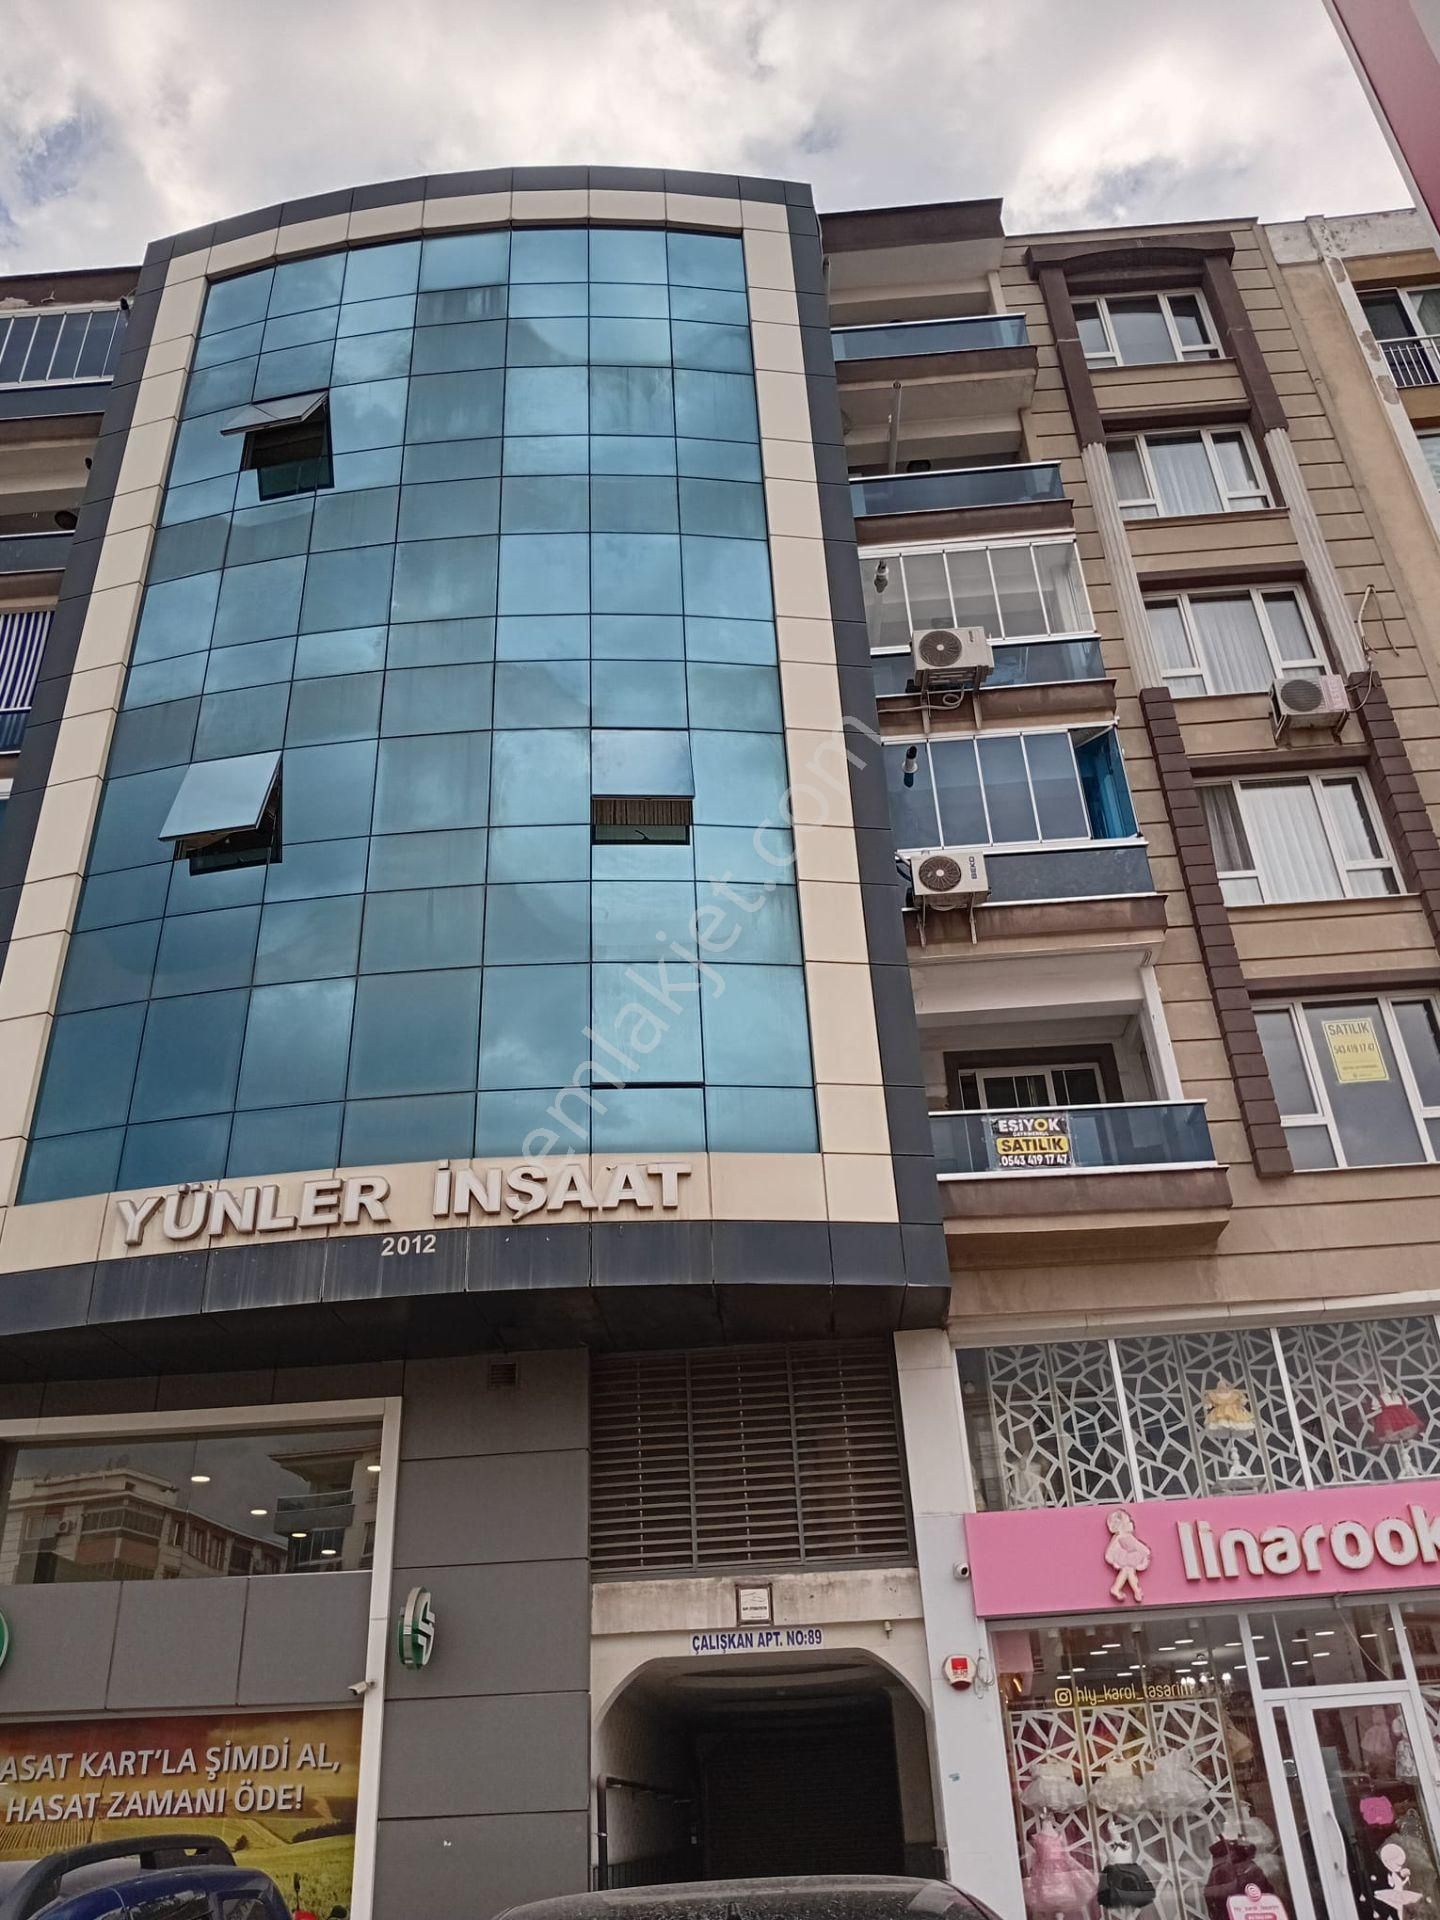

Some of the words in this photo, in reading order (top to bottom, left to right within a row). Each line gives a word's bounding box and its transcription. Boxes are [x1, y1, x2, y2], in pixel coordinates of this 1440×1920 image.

[1327, 1022, 1370, 1036] SATILIK
[1001, 1137, 1064, 1152] SATILIK
[1001, 1154, 1026, 1166] 0543
[1027, 1154, 1044, 1165] 419
[1045, 1153, 1055, 1165] 17
[1056, 1153, 1068, 1164] 47
[116, 1175, 391, 1245] YÜNLER
[432, 1158, 692, 1222] İNŞAAT
[381, 1234, 437, 1256] 2012
[1177, 1504, 1440, 1581] linarook
[692, 1632, 754, 1655] ÇALIŞKAN
[757, 1631, 783, 1647] APT.
[786, 1629, 822, 1646] NO:89
[79, 1748, 197, 1778] KART'LA
[205, 1737, 290, 1781] ŞİMDİ
[296, 1742, 341, 1773] AL,
[5, 1791, 100, 1823] HASAT
[106, 1787, 227, 1818] ZAMANI
[234, 1779, 305, 1812] ÖDE!
